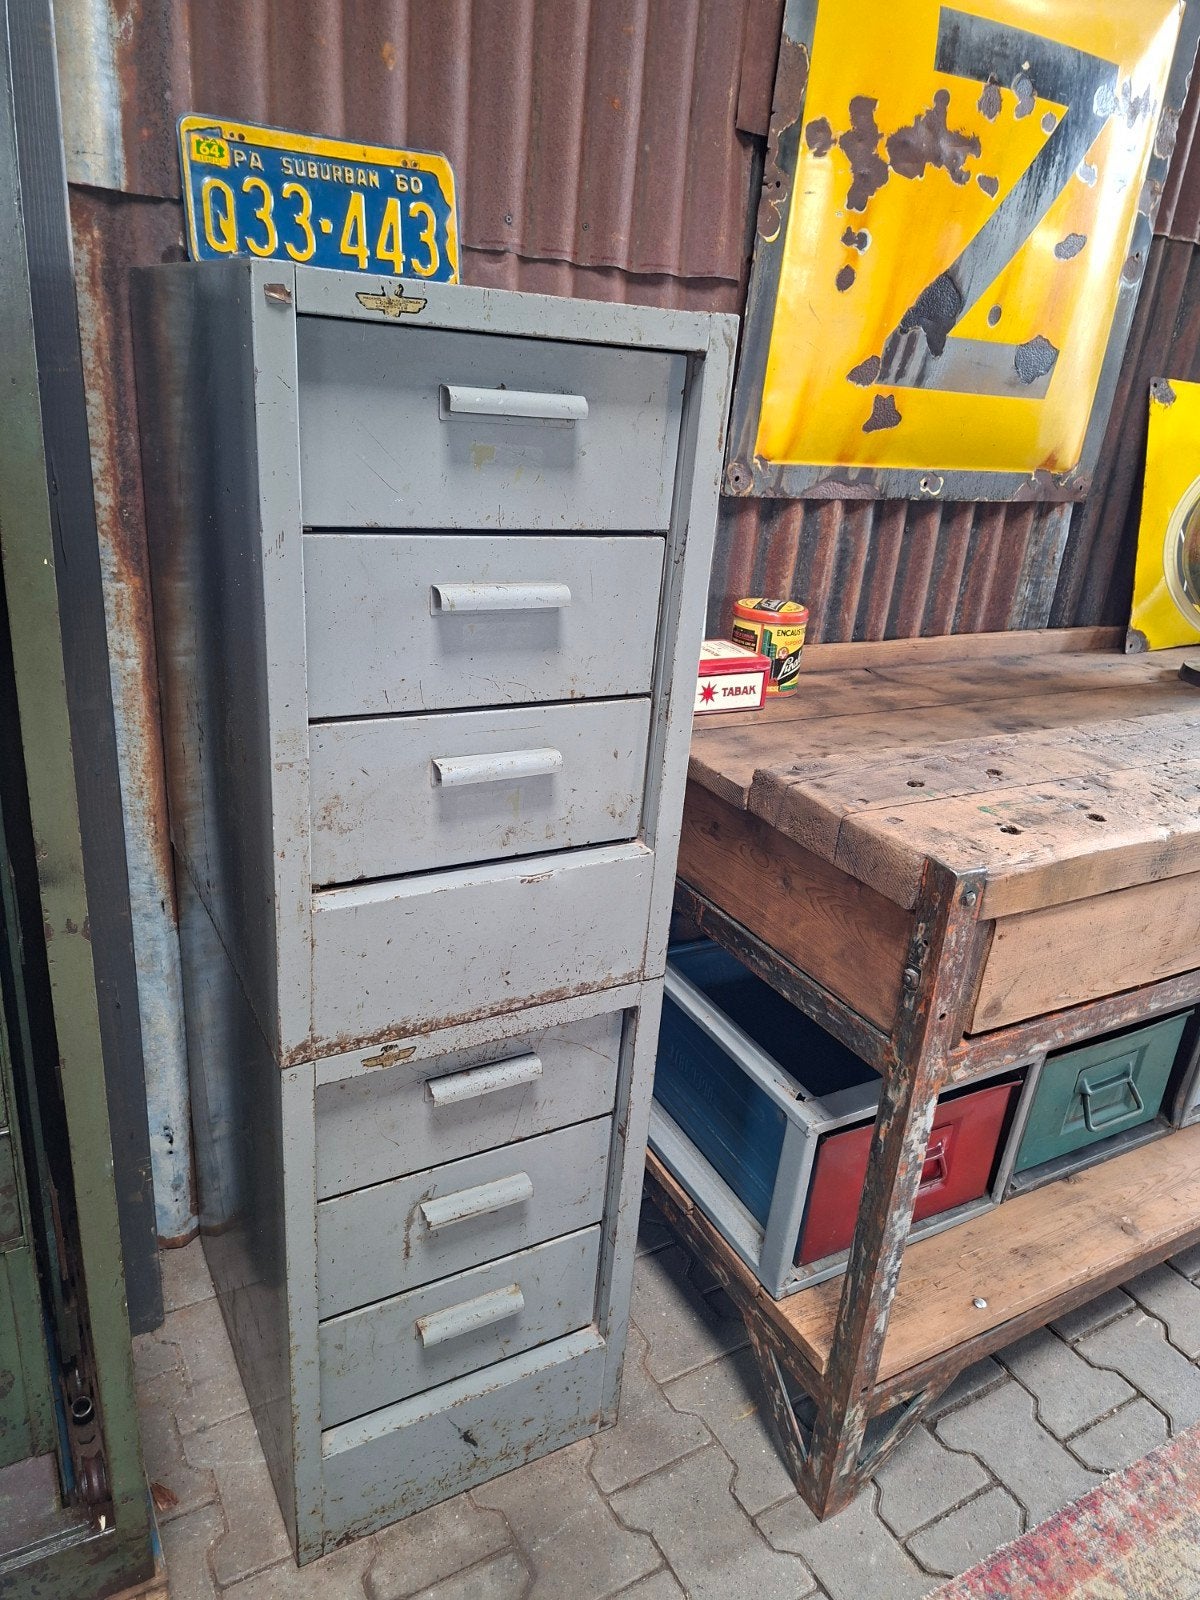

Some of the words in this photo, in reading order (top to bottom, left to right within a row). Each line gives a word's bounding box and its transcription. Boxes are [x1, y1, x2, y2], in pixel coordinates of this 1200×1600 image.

[199, 141, 220, 158] 64
[233, 149, 264, 171] PA
[280, 155, 380, 189] SUBURBAN
[721, 684, 757, 697] TABAK
